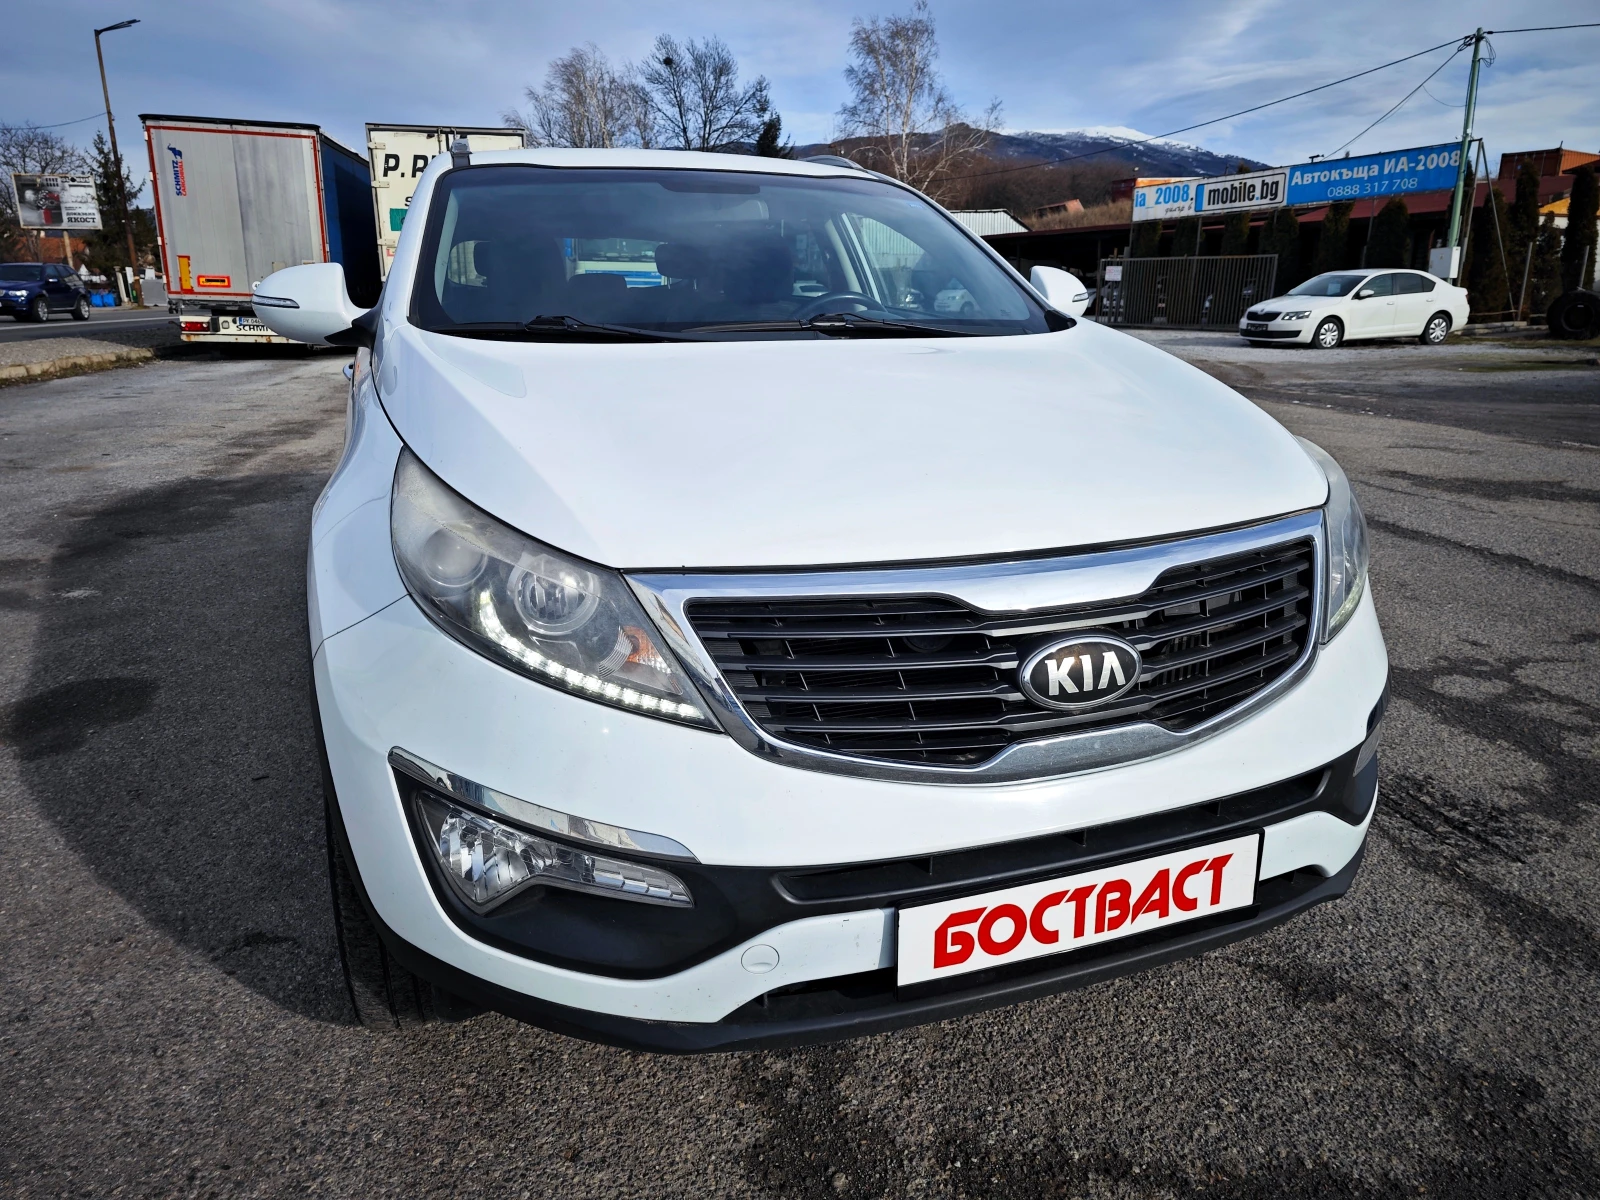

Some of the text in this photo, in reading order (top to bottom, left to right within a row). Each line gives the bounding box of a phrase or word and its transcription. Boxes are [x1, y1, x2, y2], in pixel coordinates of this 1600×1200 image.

[172, 160, 182, 196] SCHMITZ
[178, 161, 187, 196] CARGOBULL
[1291, 150, 1460, 186] Автокъща ИА-2008
[1207, 179, 1280, 206] mobile.bg
[1327, 178, 1418, 198] 0888 317 708
[1044, 651, 1126, 696] KIA
[934, 853, 1234, 969] БОСТВАСТ
